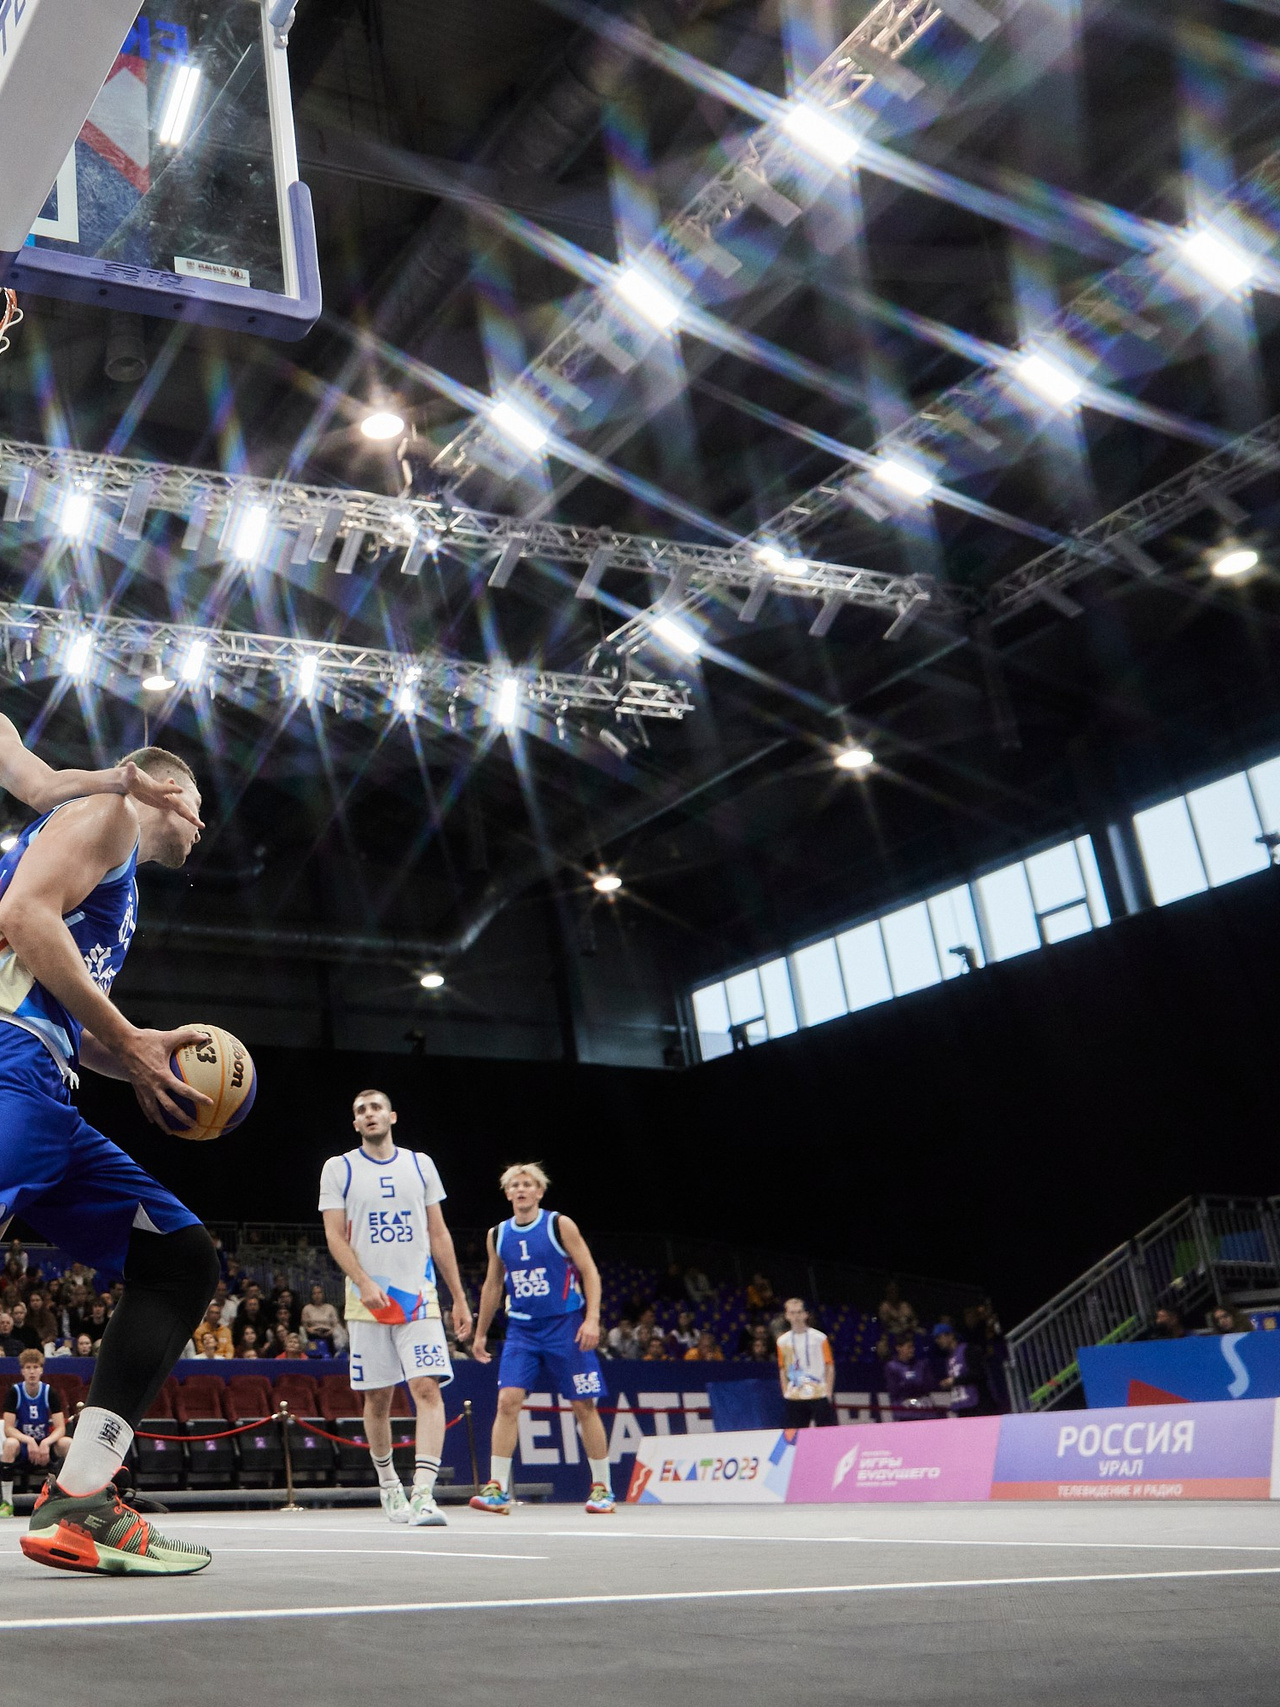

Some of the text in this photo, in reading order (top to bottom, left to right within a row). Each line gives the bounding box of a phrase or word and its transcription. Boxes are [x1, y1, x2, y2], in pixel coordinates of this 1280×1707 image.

[379, 1176, 396, 1198] 5
[369, 1210, 412, 1226] EKAT
[370, 1225, 414, 1244] 2023
[519, 1240, 531, 1261] 1
[514, 1279, 551, 1298] 2023
[1056, 1419, 1196, 1458] РОССИЯ
[1098, 1459, 1144, 1478] УРАЛ
[1058, 1484, 1183, 1498] ТЕЛЕВИДЕНИЕ И РАДИО
